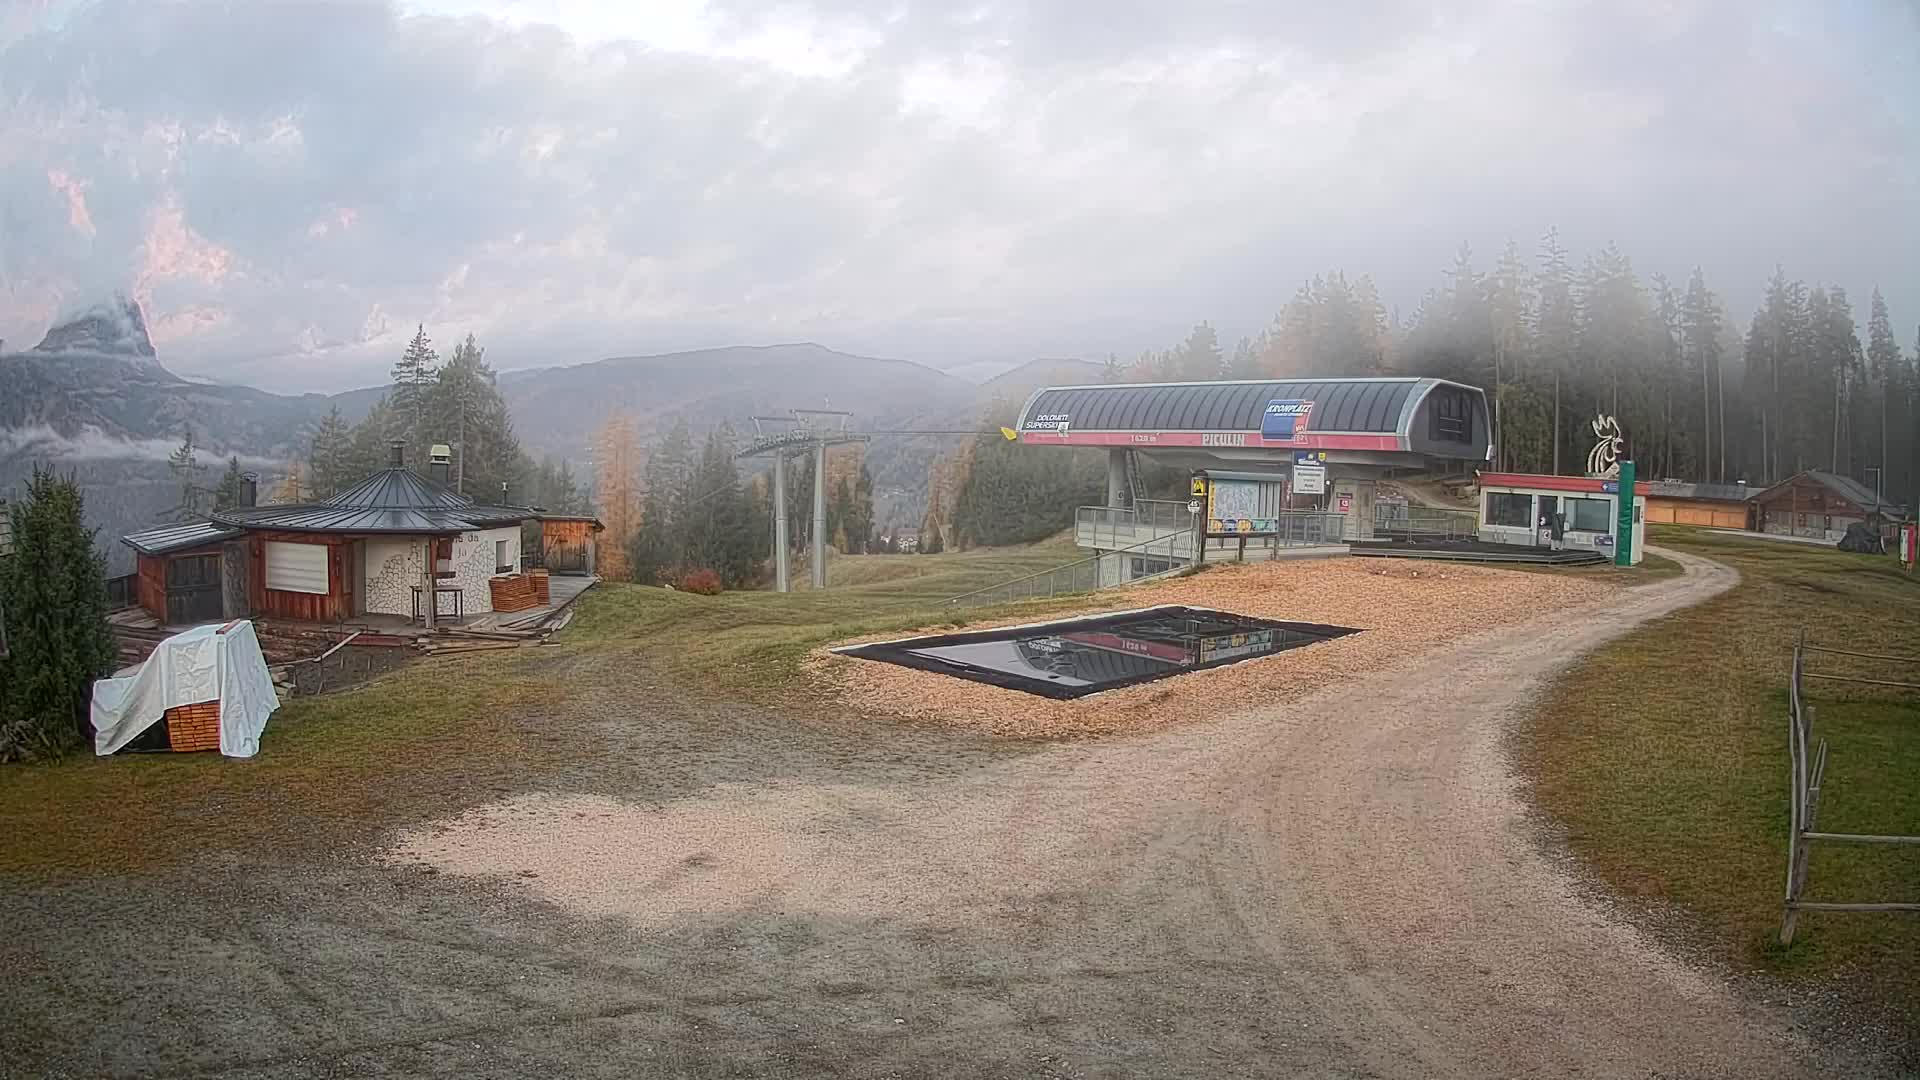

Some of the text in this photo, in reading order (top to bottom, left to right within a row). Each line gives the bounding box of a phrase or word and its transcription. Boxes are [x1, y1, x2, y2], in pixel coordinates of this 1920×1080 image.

[1266, 404, 1312, 413] KRONPLATZ
[1026, 421, 1059, 429] SUPERSKI
[1202, 433, 1245, 447] PICULIN
